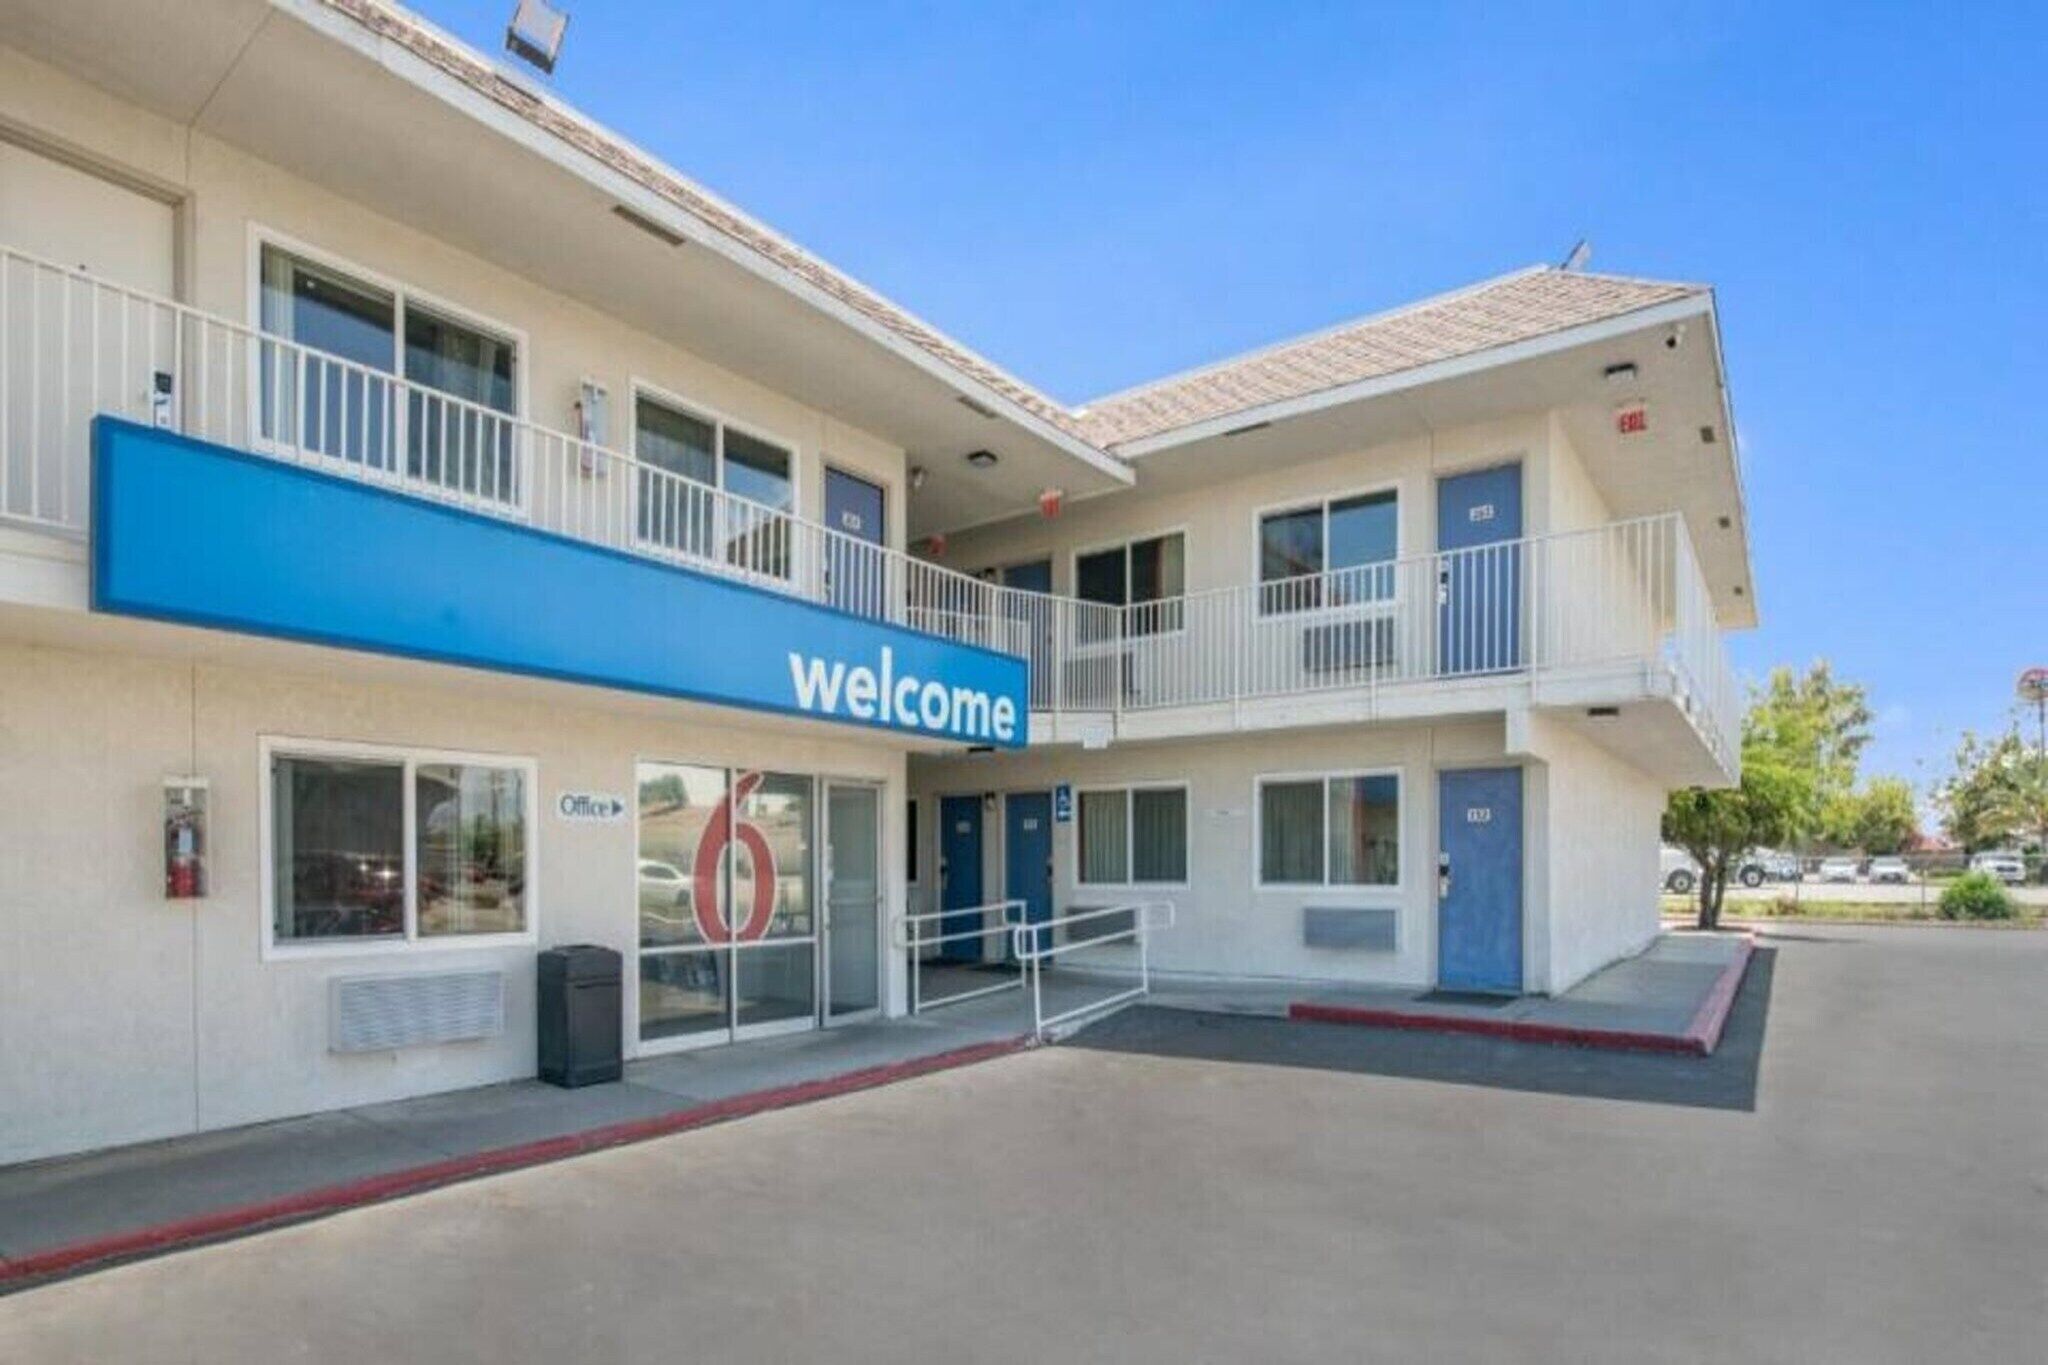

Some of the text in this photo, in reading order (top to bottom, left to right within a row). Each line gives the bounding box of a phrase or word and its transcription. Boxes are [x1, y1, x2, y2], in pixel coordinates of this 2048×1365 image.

[788, 646, 1017, 741] welcome
[561, 794, 609, 817] Office
[692, 772, 777, 946] 6
